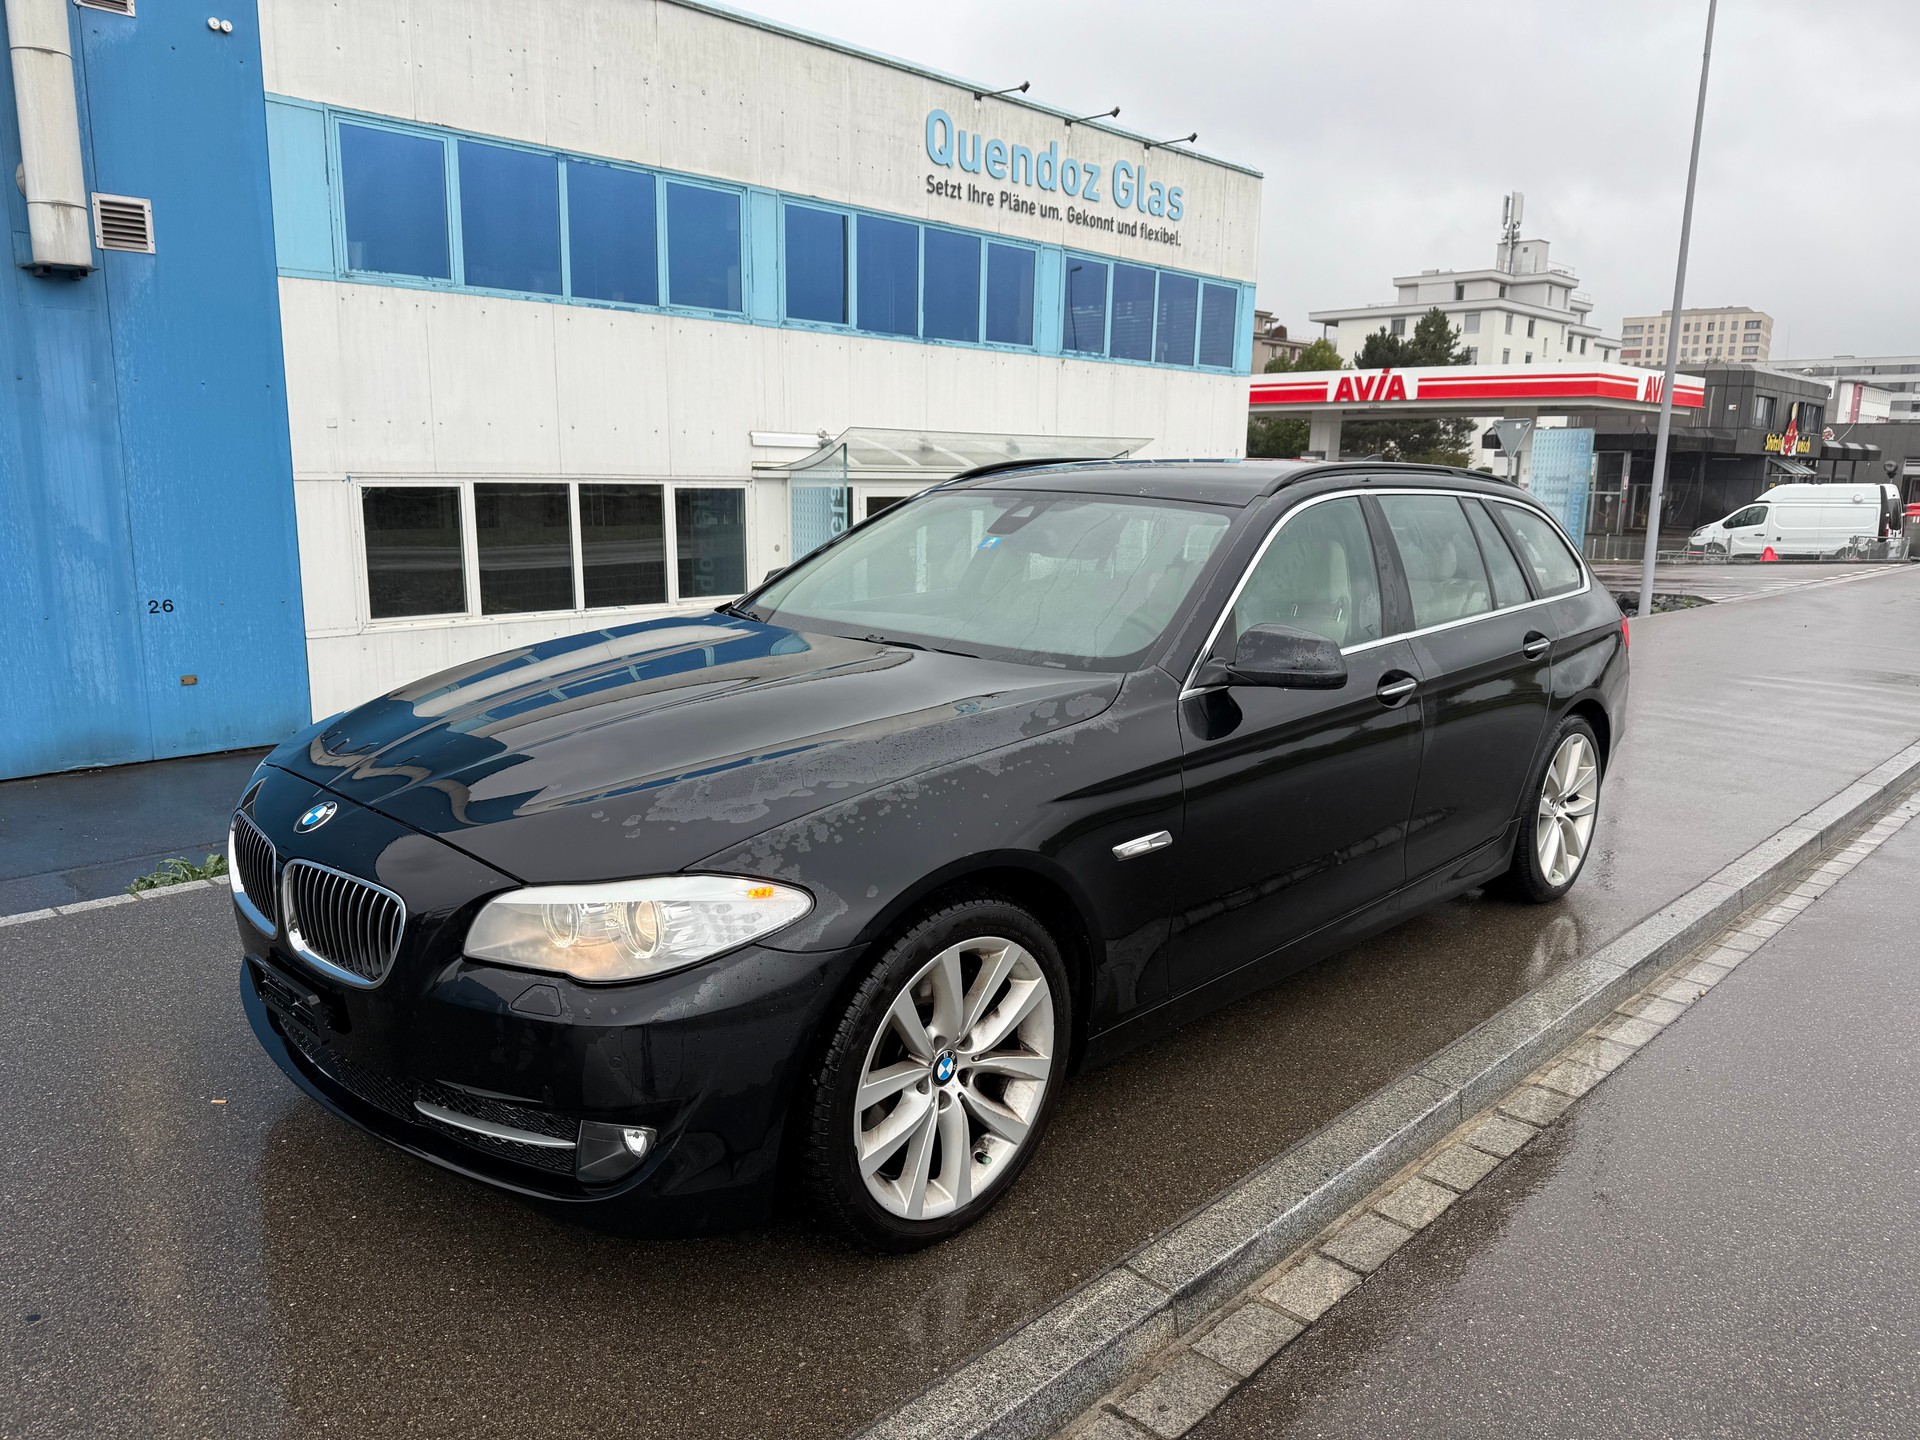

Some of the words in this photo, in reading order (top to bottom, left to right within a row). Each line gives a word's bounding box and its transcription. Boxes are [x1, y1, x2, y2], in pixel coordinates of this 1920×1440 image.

[926, 109, 1101, 202] Quendoz
[1112, 160, 1184, 221] Glas
[926, 174, 962, 200] Setzt
[968, 184, 995, 206] Ihre
[1000, 190, 1036, 216] Pläne
[1040, 203, 1063, 222] um.
[1067, 206, 1114, 233] Gekonnt
[1117, 219, 1137, 238] und
[1140, 222, 1182, 247] flexibel.
[1334, 368, 1407, 401] AVIA
[1644, 376, 1665, 403] AVI
[148, 599, 174, 614] 26
